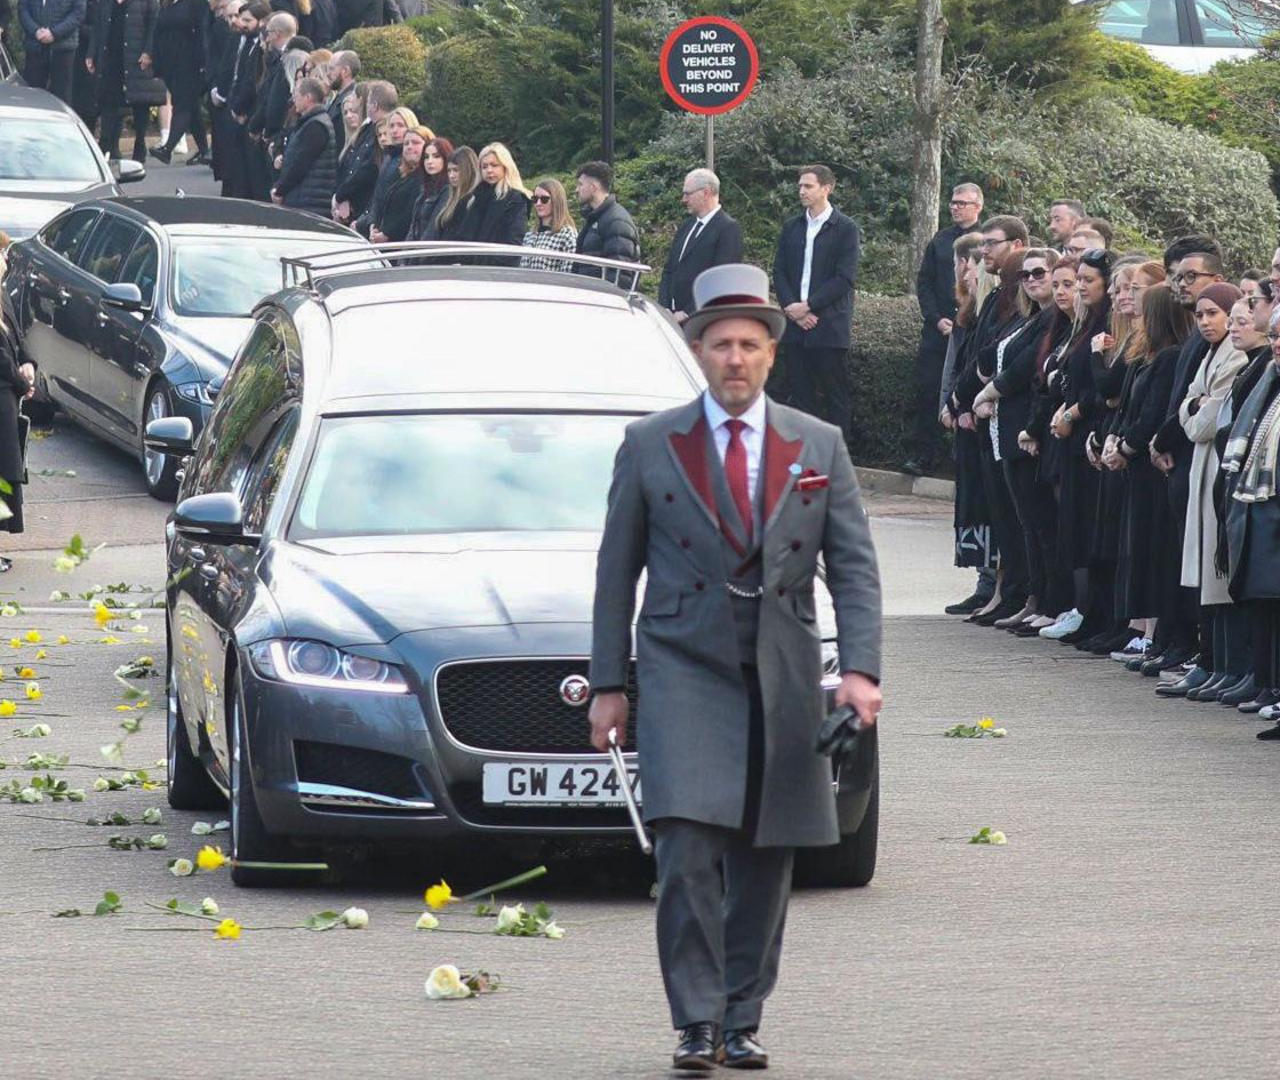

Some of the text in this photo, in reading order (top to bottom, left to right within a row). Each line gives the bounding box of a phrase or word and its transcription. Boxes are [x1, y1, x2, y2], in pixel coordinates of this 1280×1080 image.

[700, 30, 717, 40] NO
[683, 43, 735, 54] DELIVERY
[682, 56, 736, 67] VEHICLES
[686, 70, 733, 80] BEYOND
[679, 82, 740, 94] THIS POINT
[508, 767, 641, 797] GW 4247
